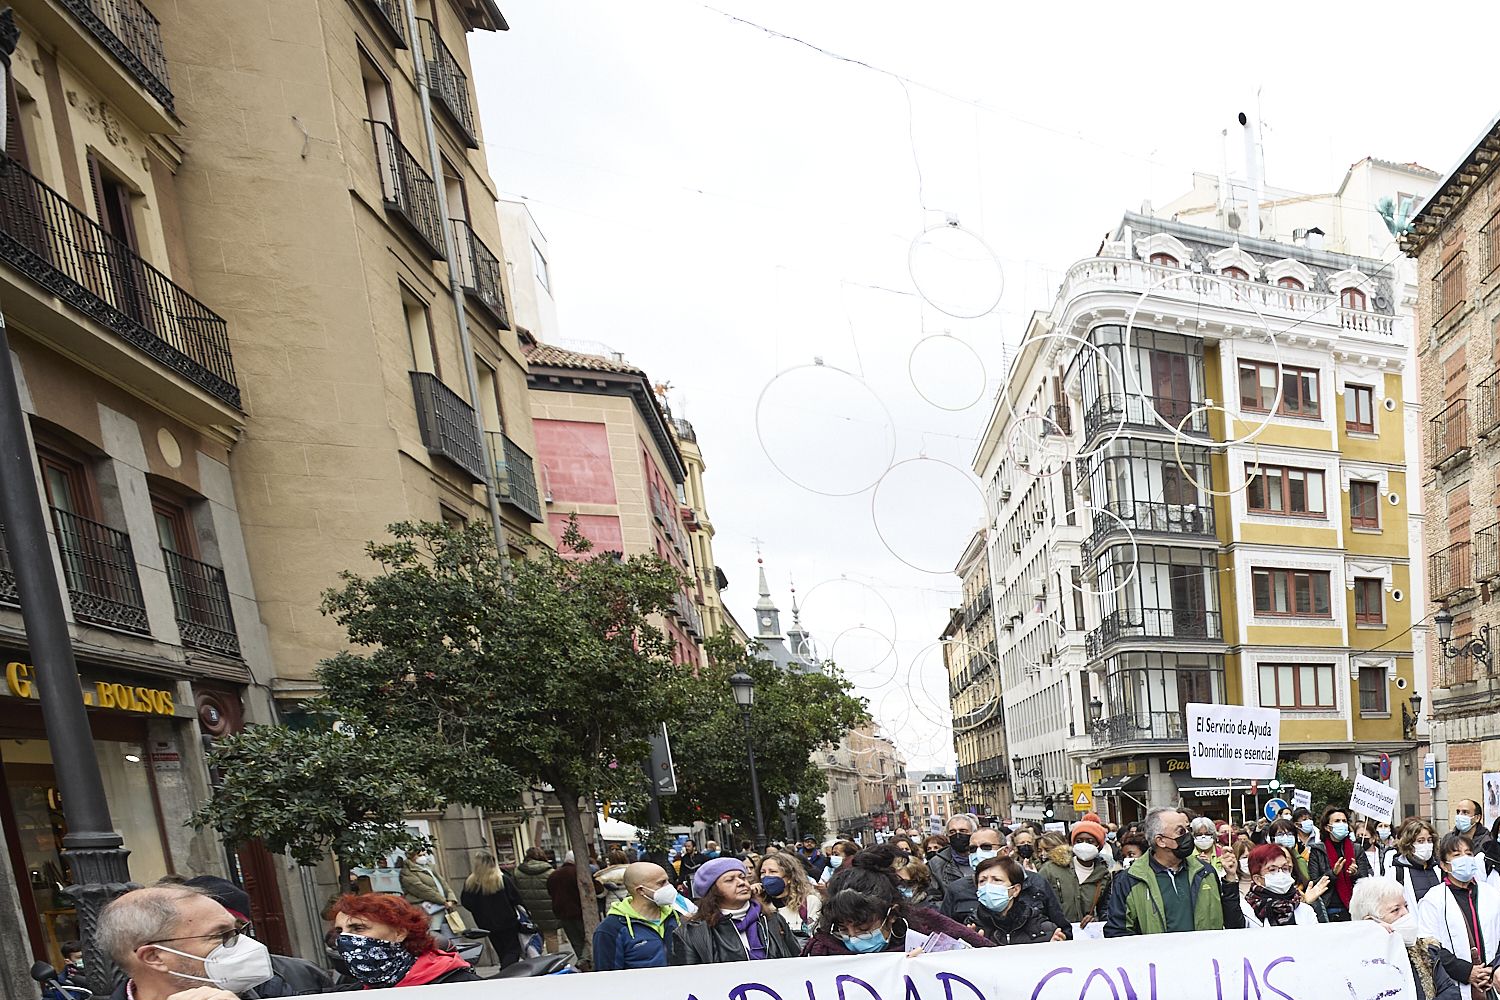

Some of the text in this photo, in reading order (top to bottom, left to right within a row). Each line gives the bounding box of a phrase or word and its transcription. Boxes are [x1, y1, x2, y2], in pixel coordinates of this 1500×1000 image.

[94, 681, 175, 716] BOLSOS
[1196, 717, 1272, 740] El Servicio de Ayuda
[1192, 742, 1276, 761] a Domicilio es esencial.
[1356, 782, 1394, 805] Salarios injustos
